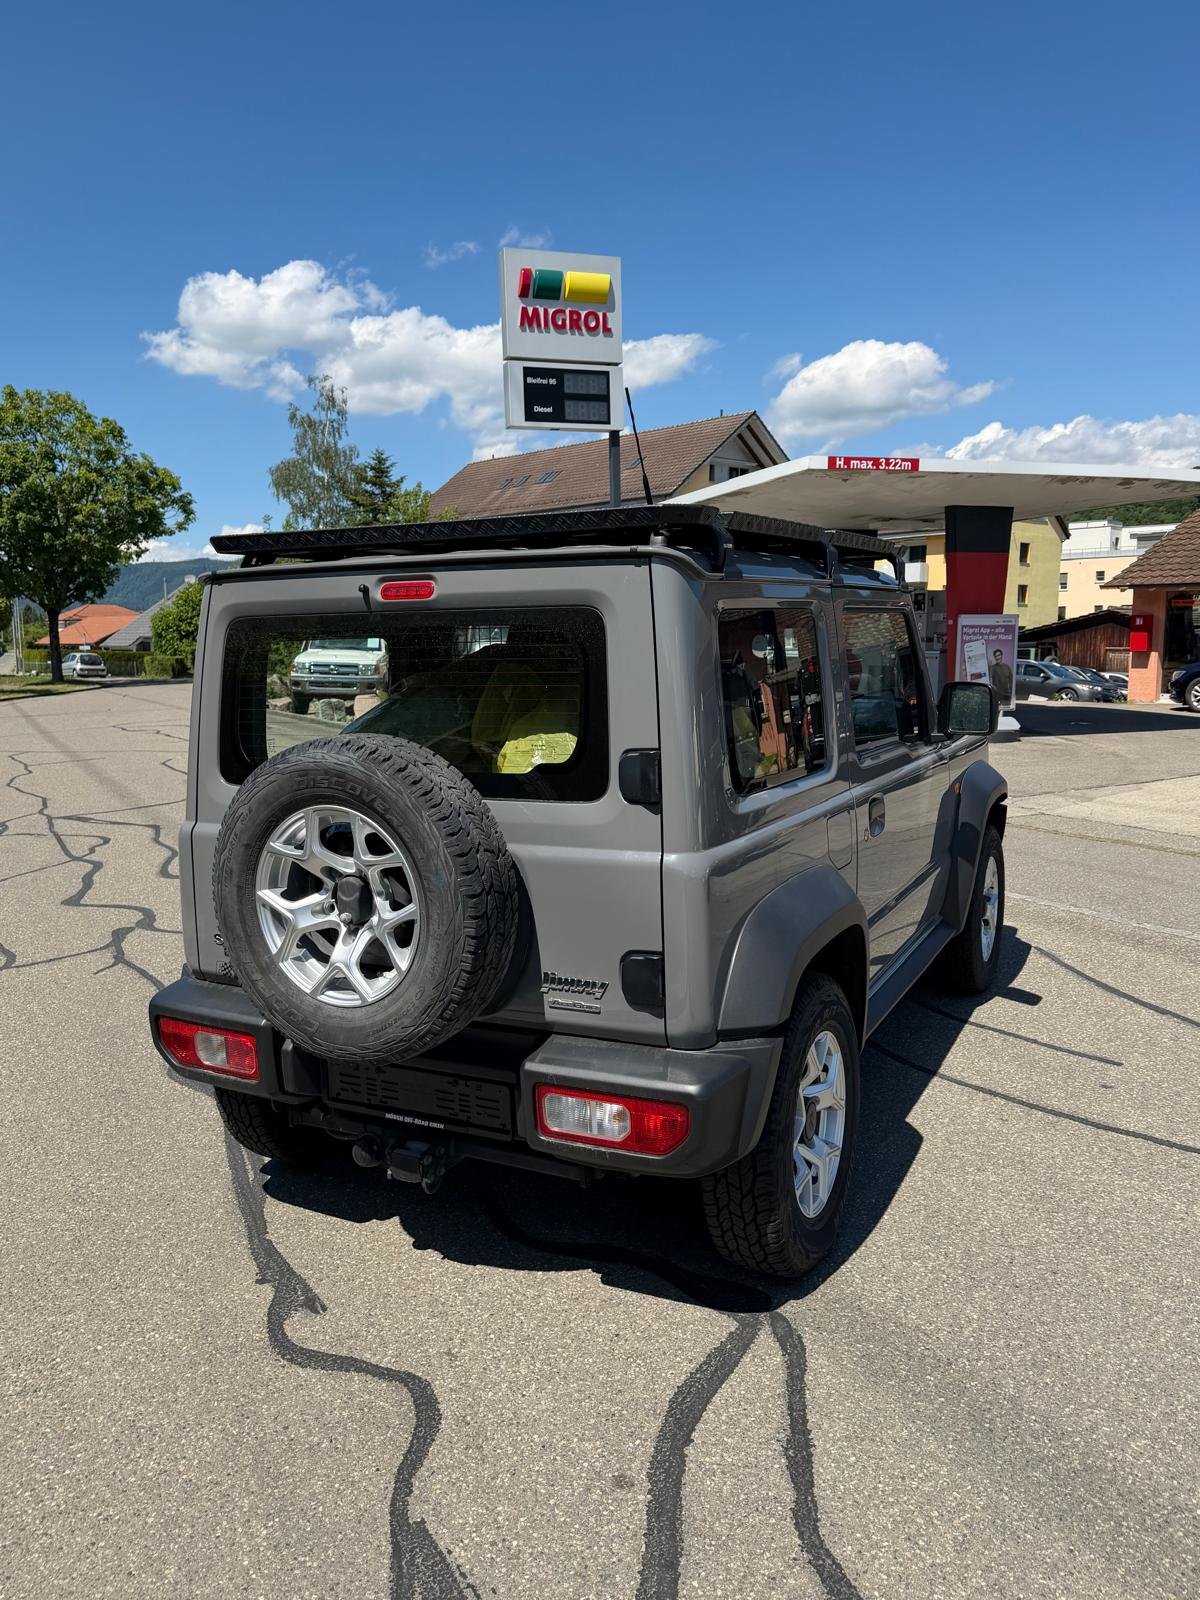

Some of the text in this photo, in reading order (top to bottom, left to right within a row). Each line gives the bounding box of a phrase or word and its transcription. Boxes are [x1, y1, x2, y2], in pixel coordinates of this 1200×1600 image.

[519, 305, 612, 334] MIGROL
[526, 376, 548, 385] Bleifrei
[533, 405, 553, 413] Diesel
[835, 457, 912, 470] H. max. 3.22m
[962, 626, 980, 634] Migrol
[980, 626, 990, 634] App
